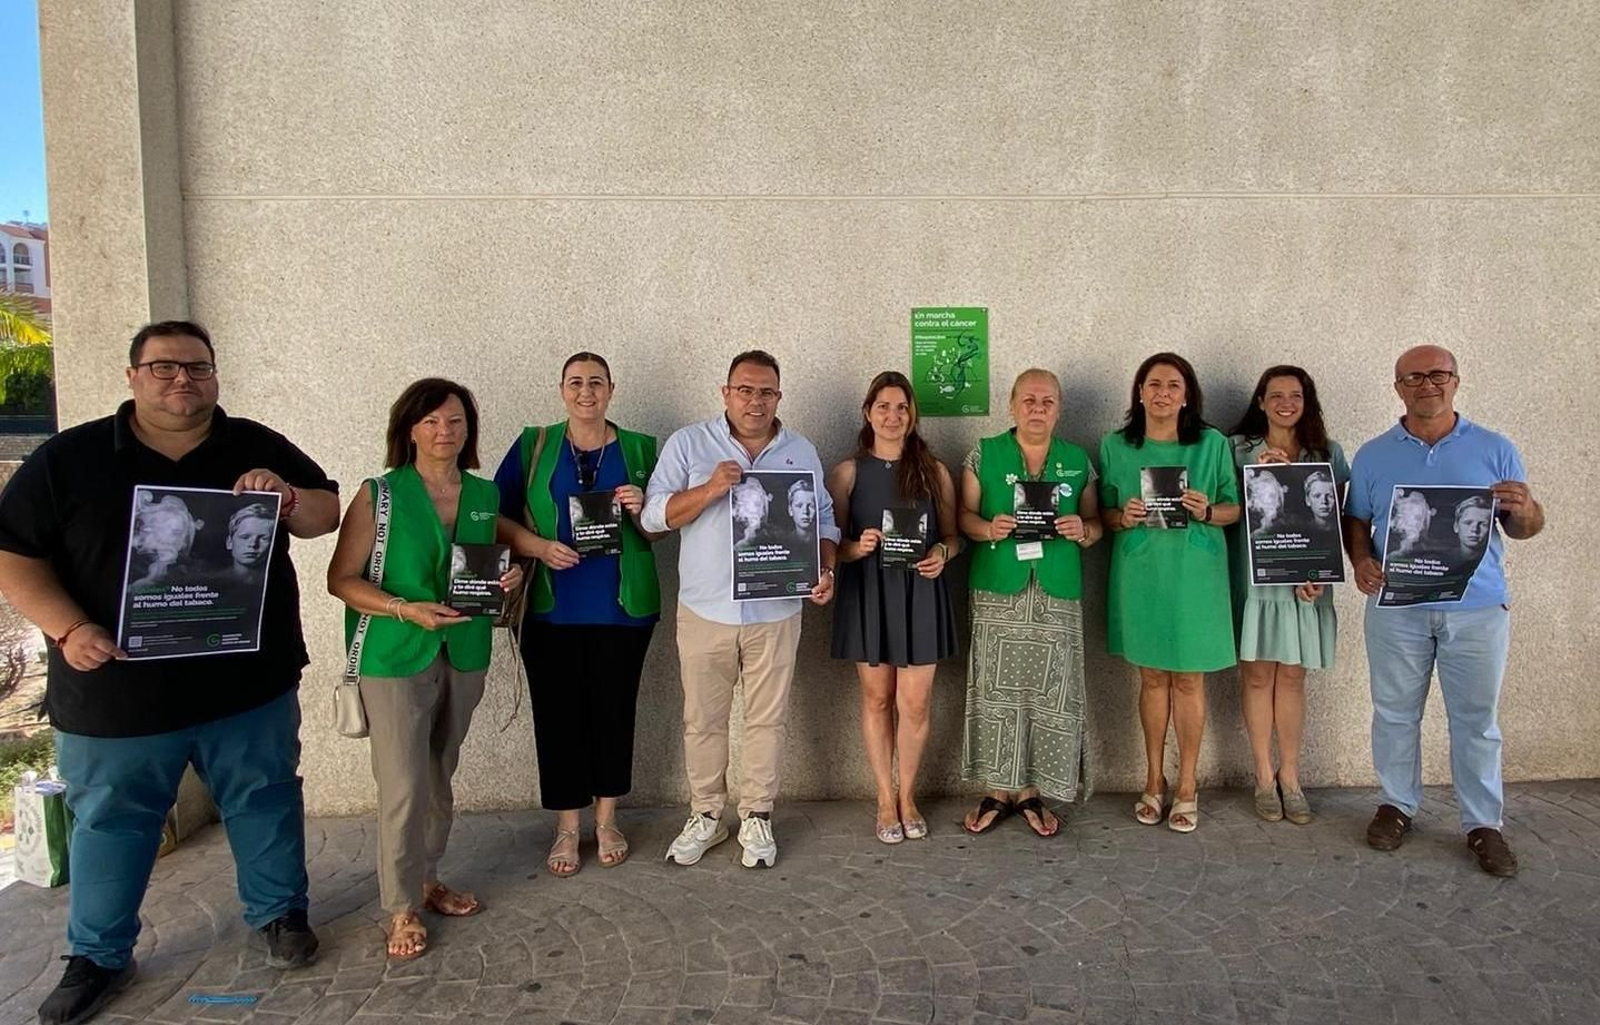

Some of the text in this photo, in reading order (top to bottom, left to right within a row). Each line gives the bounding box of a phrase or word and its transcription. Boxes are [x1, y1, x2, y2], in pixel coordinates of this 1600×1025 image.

[378, 523, 386, 544] NOT
[372, 551, 382, 588] ORDIN
[164, 593, 194, 601] iguales
[348, 614, 368, 675] NOT ORDIN
